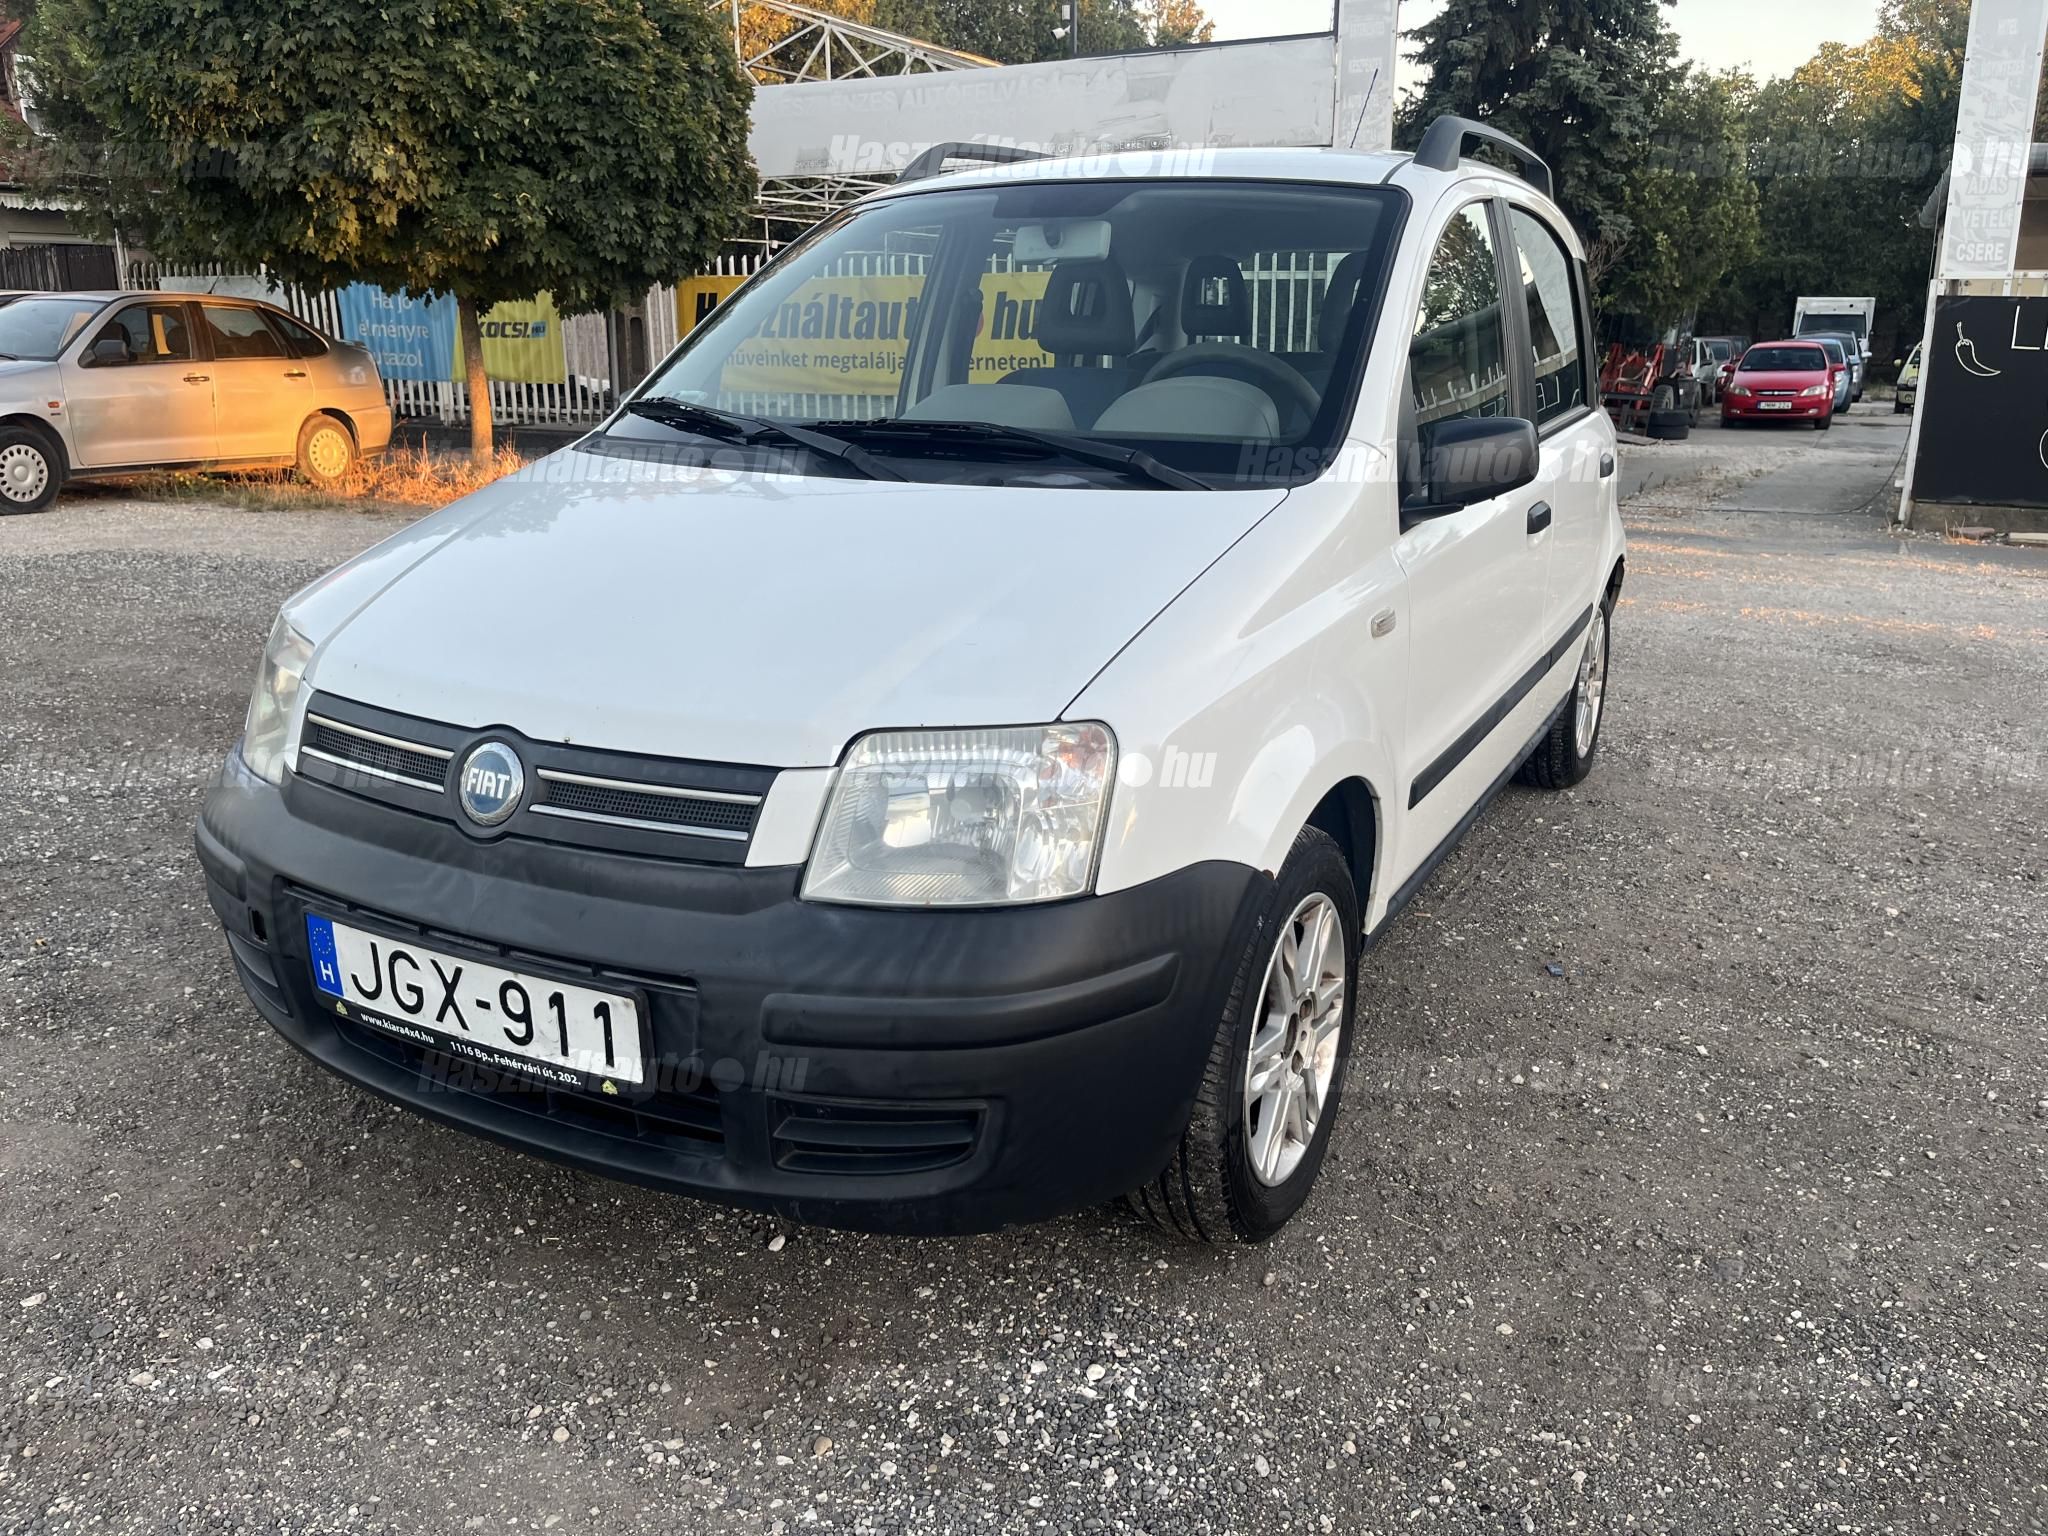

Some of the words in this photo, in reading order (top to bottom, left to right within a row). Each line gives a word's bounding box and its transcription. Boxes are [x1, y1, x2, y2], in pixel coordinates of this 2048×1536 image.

[1956, 243, 2004, 262] CSERE
[358, 319, 429, 342] élményre
[466, 767, 510, 799] FIAT
[319, 960, 335, 984] H
[351, 941, 615, 1068] JGX-911
[361, 1012, 435, 1045] www.kiara4x4.hu
[450, 1041, 474, 1056] 1116
[475, 1045, 494, 1063] Bp.,
[494, 1054, 541, 1075] Fehérvári
[542, 1066, 557, 1081] út,
[557, 1071, 582, 1085] 202.
